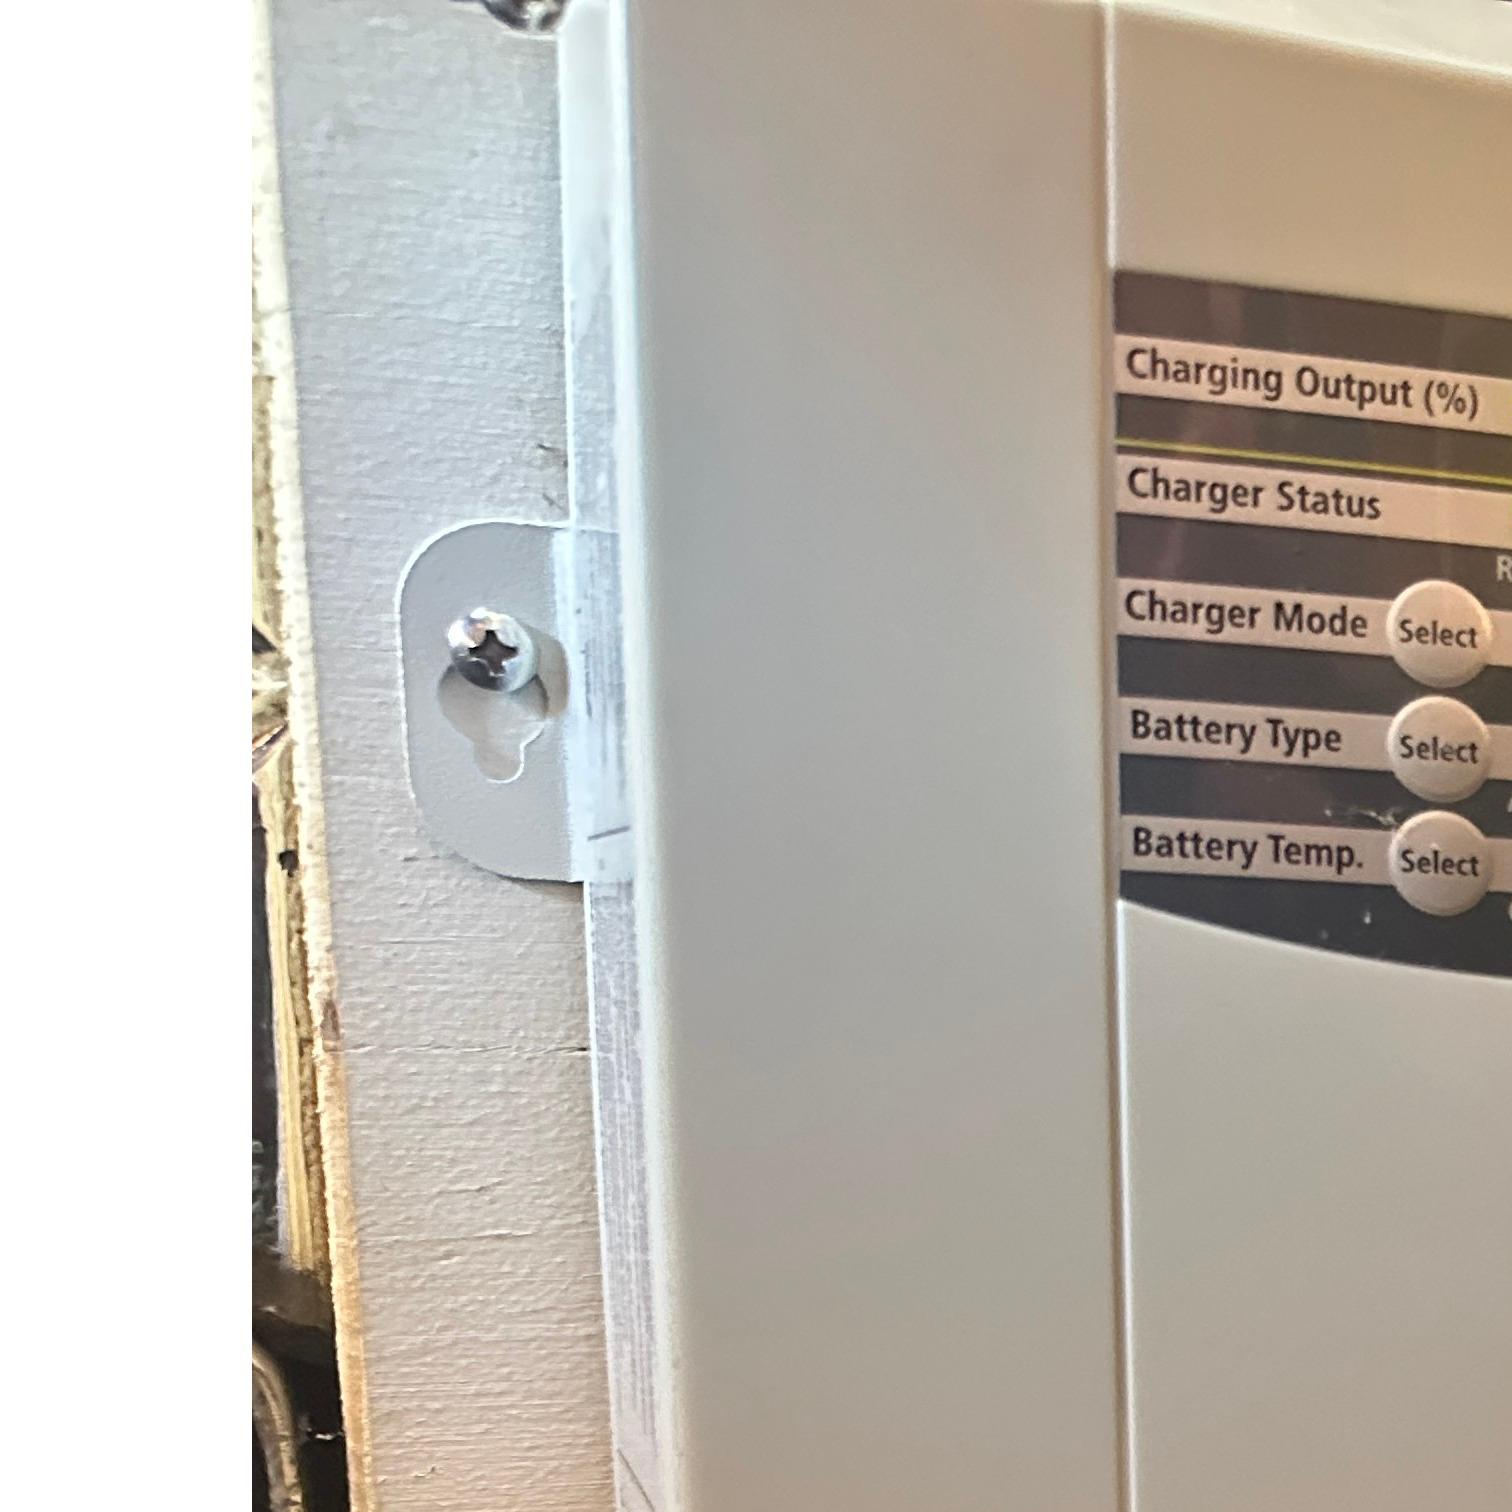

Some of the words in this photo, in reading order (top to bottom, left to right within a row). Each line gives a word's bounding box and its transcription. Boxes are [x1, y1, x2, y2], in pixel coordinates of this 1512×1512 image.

[1126, 348, 1283, 402] Charging
[1296, 366, 1413, 411] Output
[1423, 379, 1479, 421] (%)
[1129, 467, 1264, 513] Charger
[1278, 481, 1381, 519] Status
[1126, 590, 1261, 634] Charger
[1273, 601, 1367, 638] Mode
[1399, 619, 1477, 649] Select
[1131, 709, 1256, 753] Battery
[1267, 718, 1342, 758] Type
[1400, 735, 1478, 764] Select
[1133, 826, 1257, 870] Battery
[1267, 834, 1364, 874] Temp.
[1400, 849, 1479, 877] Select
